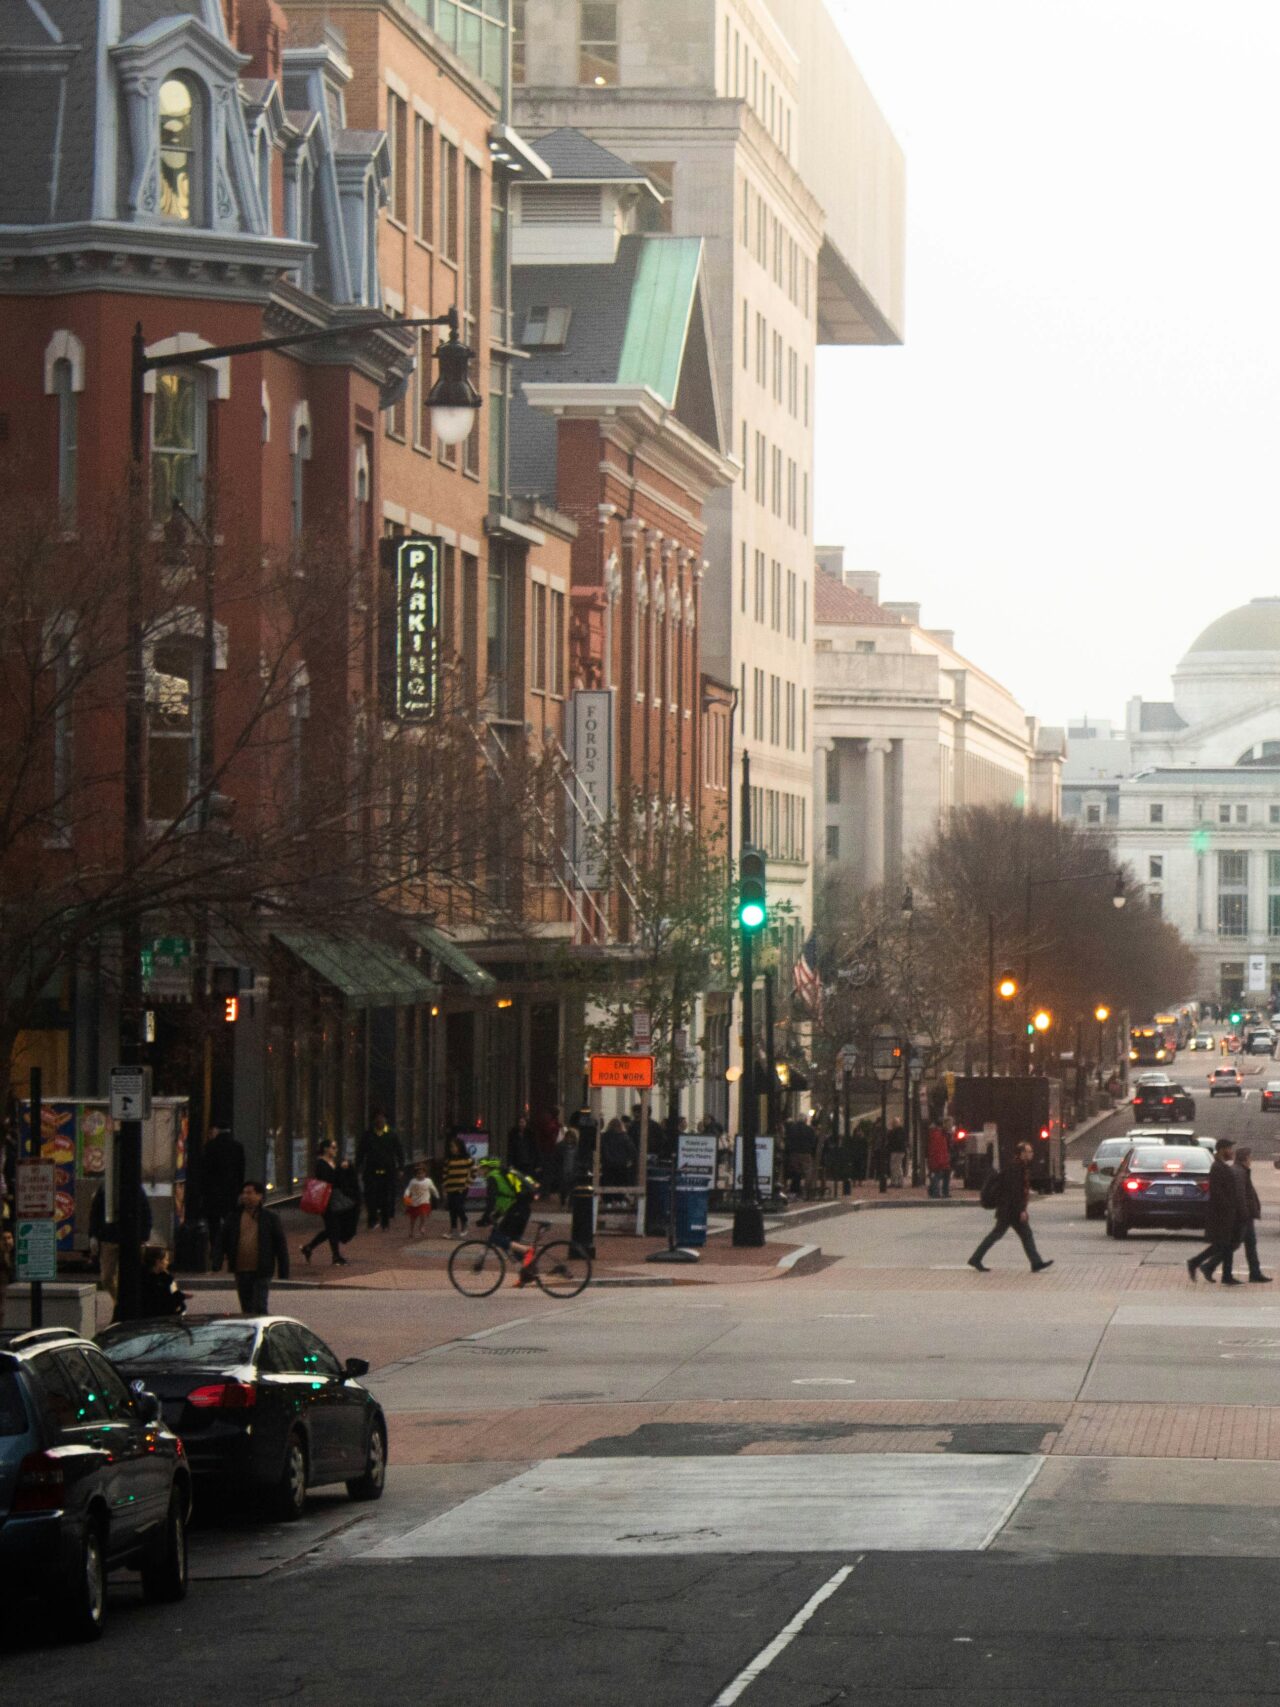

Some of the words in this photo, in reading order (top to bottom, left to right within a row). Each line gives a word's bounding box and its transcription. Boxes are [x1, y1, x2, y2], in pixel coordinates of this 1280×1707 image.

[408, 550, 426, 696] PARKING
[584, 781, 598, 876] THERE
[599, 1072, 620, 1081] ROAD
[623, 1072, 645, 1082] WORK
[614, 1061, 630, 1070] END
